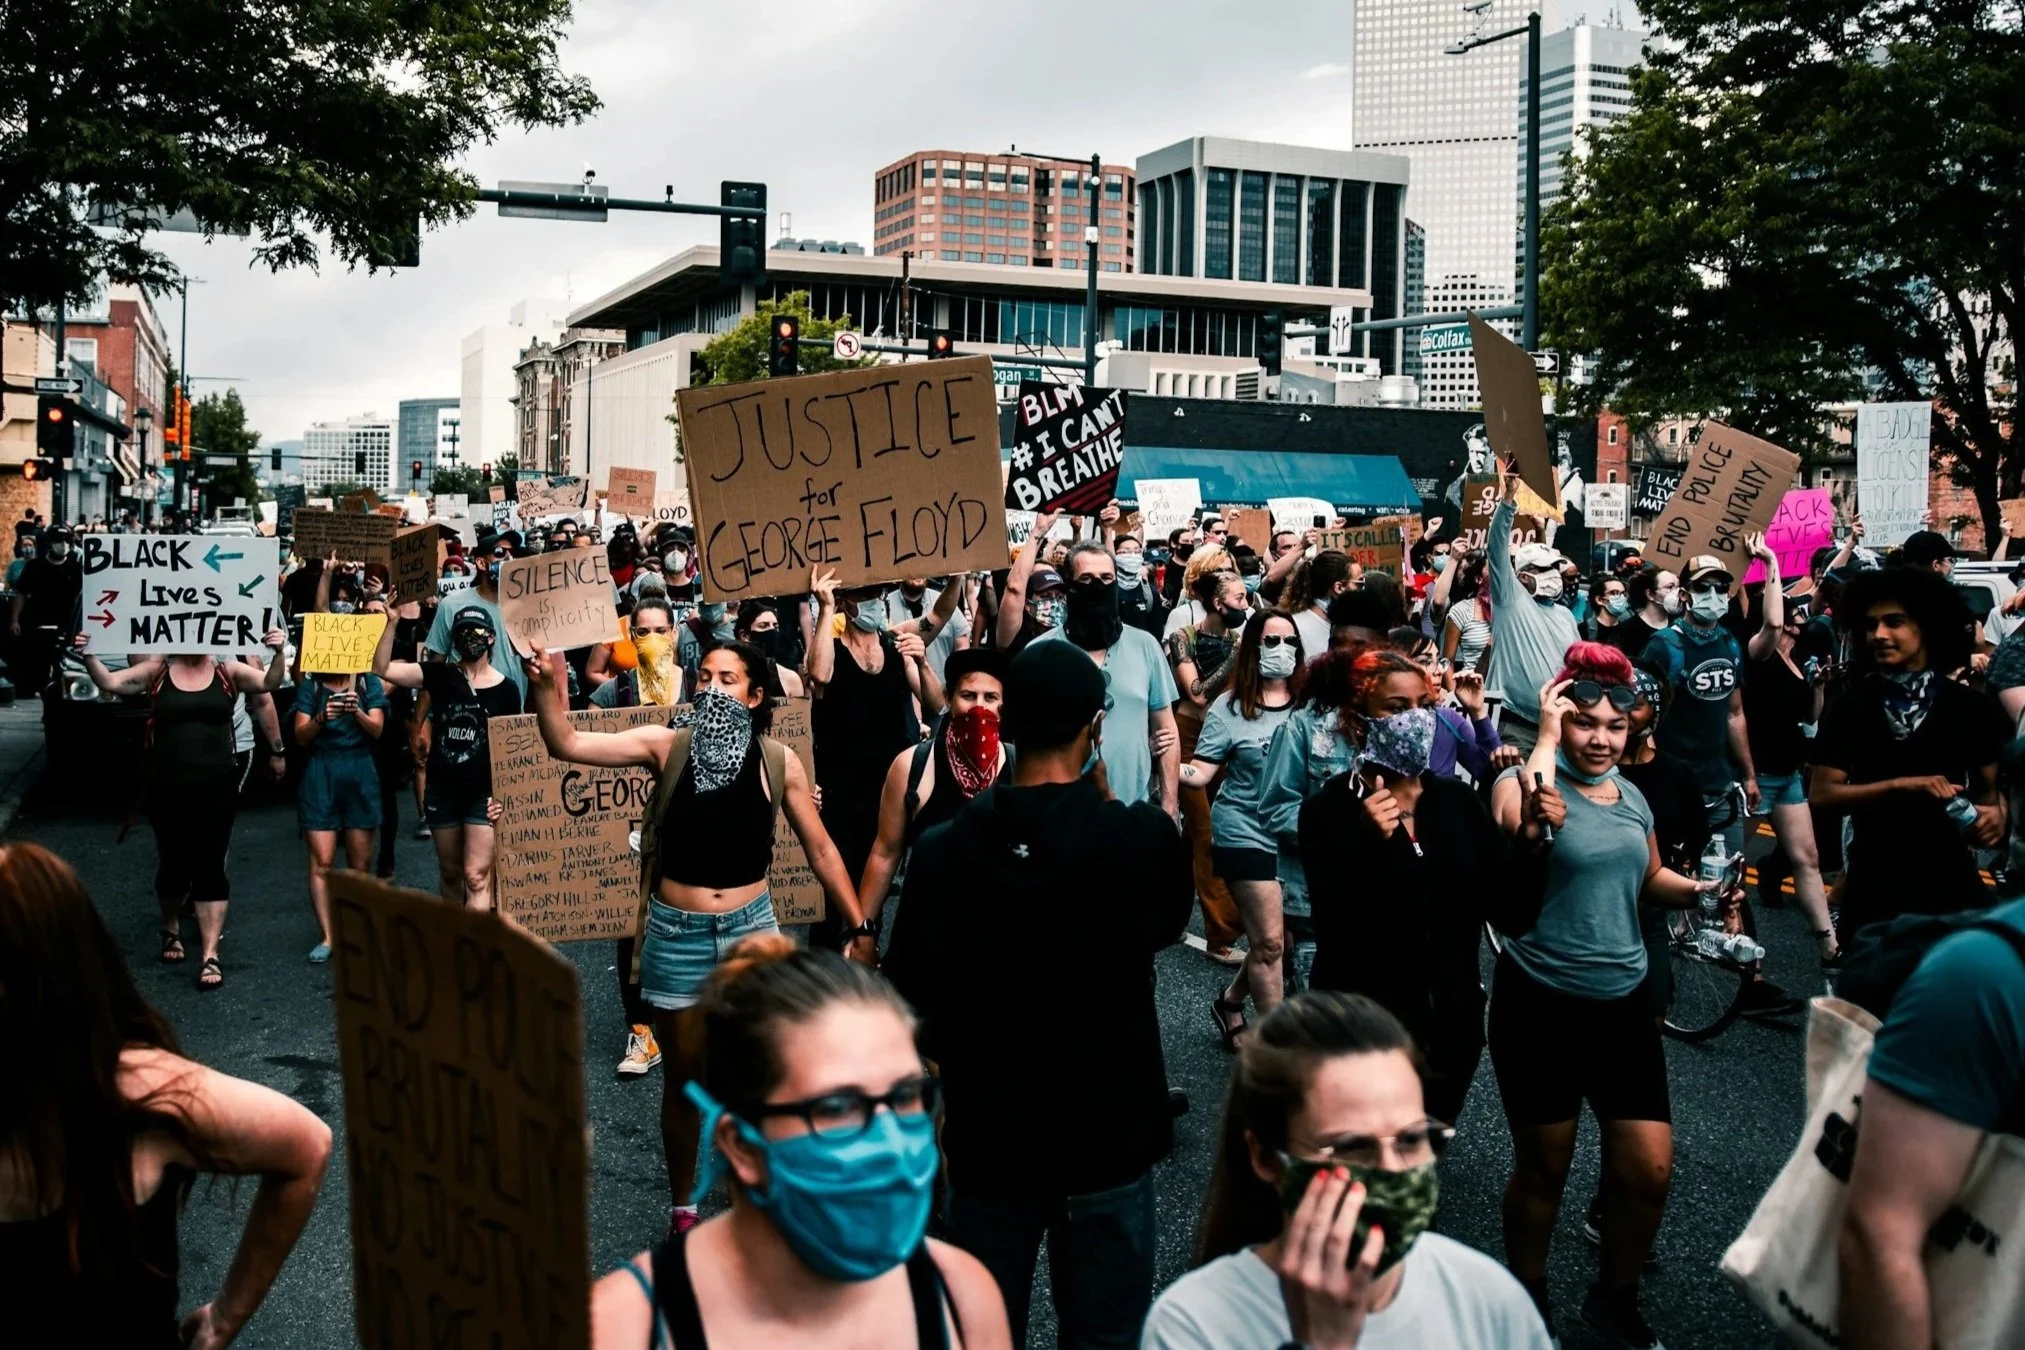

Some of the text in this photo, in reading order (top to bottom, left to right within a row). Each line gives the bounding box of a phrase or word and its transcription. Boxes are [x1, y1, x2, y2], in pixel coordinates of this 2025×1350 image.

[1431, 332, 1465, 349] Colfax
[993, 369, 1021, 384] ogan
[1022, 384, 1085, 426] BLM
[697, 376, 977, 483] JUSTICE
[1061, 388, 1125, 449] CAN'T
[1860, 407, 1930, 440] A BADGE
[1013, 426, 1123, 511] BREATHE
[1861, 449, 1929, 482] LICENSE
[1647, 471, 1682, 490] BLAC
[800, 477, 843, 514] for
[1639, 497, 1668, 512] MAT
[1647, 485, 1675, 501] LIV
[1657, 440, 1733, 558] END POLICE
[1860, 484, 1885, 513] TO
[652, 506, 688, 520] LOYD
[1337, 506, 1366, 515] catering
[1709, 460, 1773, 553] BRUTALITY
[1771, 497, 1827, 525] ACK
[707, 491, 988, 593] GEORGE FLOYD
[1321, 532, 1352, 549] IT'S
[1768, 520, 1829, 549] IVES
[83, 537, 194, 576] BLACK
[390, 531, 428, 562] BLACK
[400, 557, 425, 577] LIVES
[507, 555, 609, 600] SILENCE
[459, 581, 471, 590] ar
[130, 607, 273, 647] MATTER!
[313, 615, 364, 633] BLACK
[513, 600, 606, 642] complicity
[313, 634, 378, 653] LIVES
[1695, 668, 1735, 691] STS
[448, 725, 476, 742] VOLCÁN
[494, 715, 539, 735] SAMUE
[506, 732, 542, 753] SEA
[493, 773, 525, 789] TONY
[500, 789, 544, 812] YASSIN
[503, 804, 562, 827] MOHAMED
[505, 840, 616, 869] DARIUS TARVER
[504, 871, 551, 889] KWAME
[581, 867, 617, 881] JONES
[506, 892, 560, 912] GREGORY
[563, 890, 591, 906] HILL
[514, 914, 540, 926] IMMY
[595, 906, 634, 921] WILLIE
[570, 923, 598, 935] SHEM
[600, 919, 628, 933] JEAN
[335, 898, 435, 1031] END
[352, 1133, 406, 1254] NO
